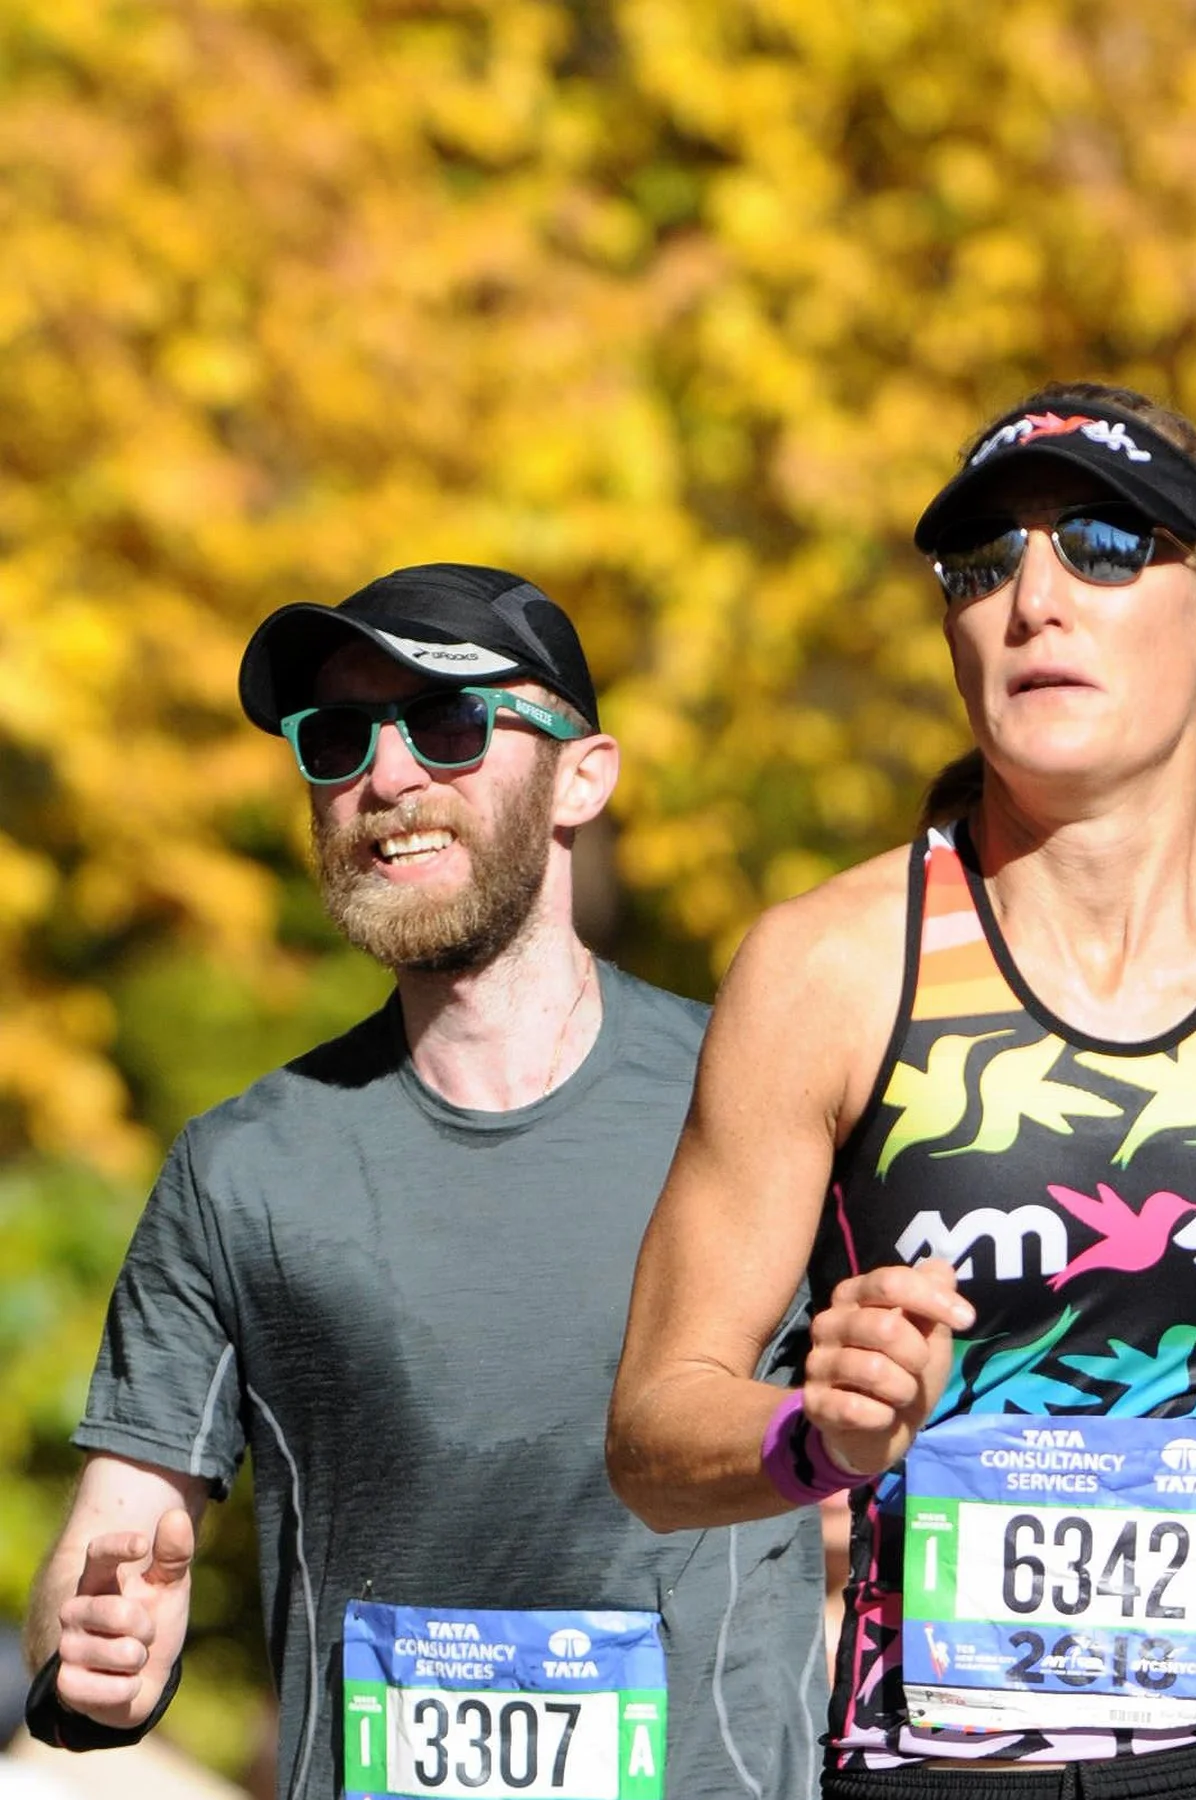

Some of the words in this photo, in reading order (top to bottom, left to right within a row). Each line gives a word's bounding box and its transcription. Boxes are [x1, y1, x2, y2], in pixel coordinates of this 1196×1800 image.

[1021, 1429, 1086, 1448] TATA
[979, 1449, 1126, 1473] CONSULTANCY
[1005, 1473, 1099, 1494] SERVICES
[1001, 1513, 1191, 1621] 6342
[426, 1621, 481, 1639] TATA
[394, 1638, 517, 1661] CONSULTANCY
[1004, 1630, 1178, 1691] 2018
[415, 1661, 495, 1680] SERVICES
[541, 1661, 599, 1679] TATA
[413, 1697, 582, 1789] 3307
[628, 1724, 656, 1778] A
